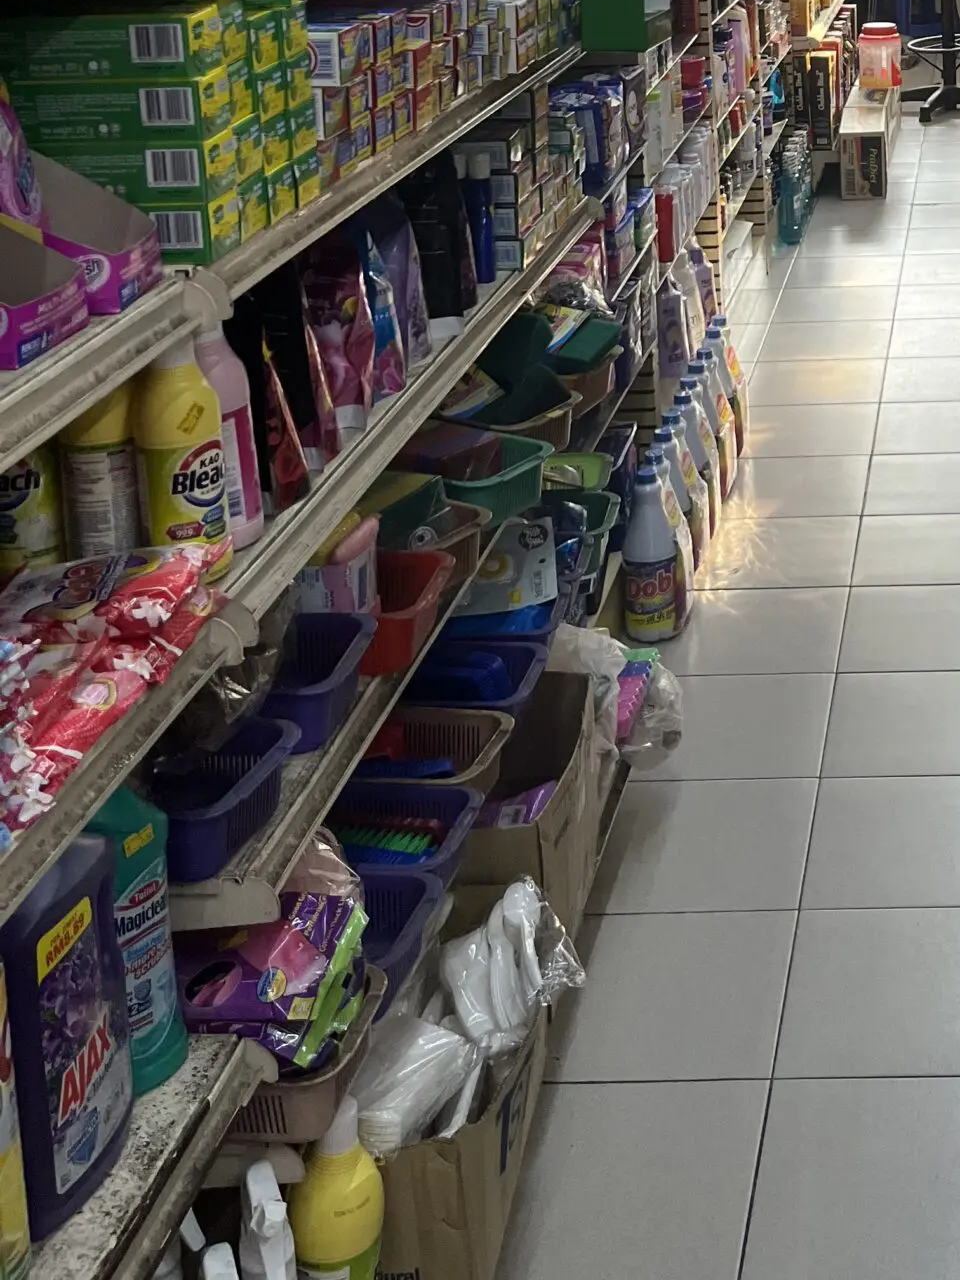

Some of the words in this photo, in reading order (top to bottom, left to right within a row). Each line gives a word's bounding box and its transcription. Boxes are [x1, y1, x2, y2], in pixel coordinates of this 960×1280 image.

[200, 452, 220, 470] KAO
[0, 469, 41, 492] ach
[171, 464, 226, 496] Blea
[114, 896, 168, 938] Magiclea
[58, 1012, 113, 1128] AJAX
